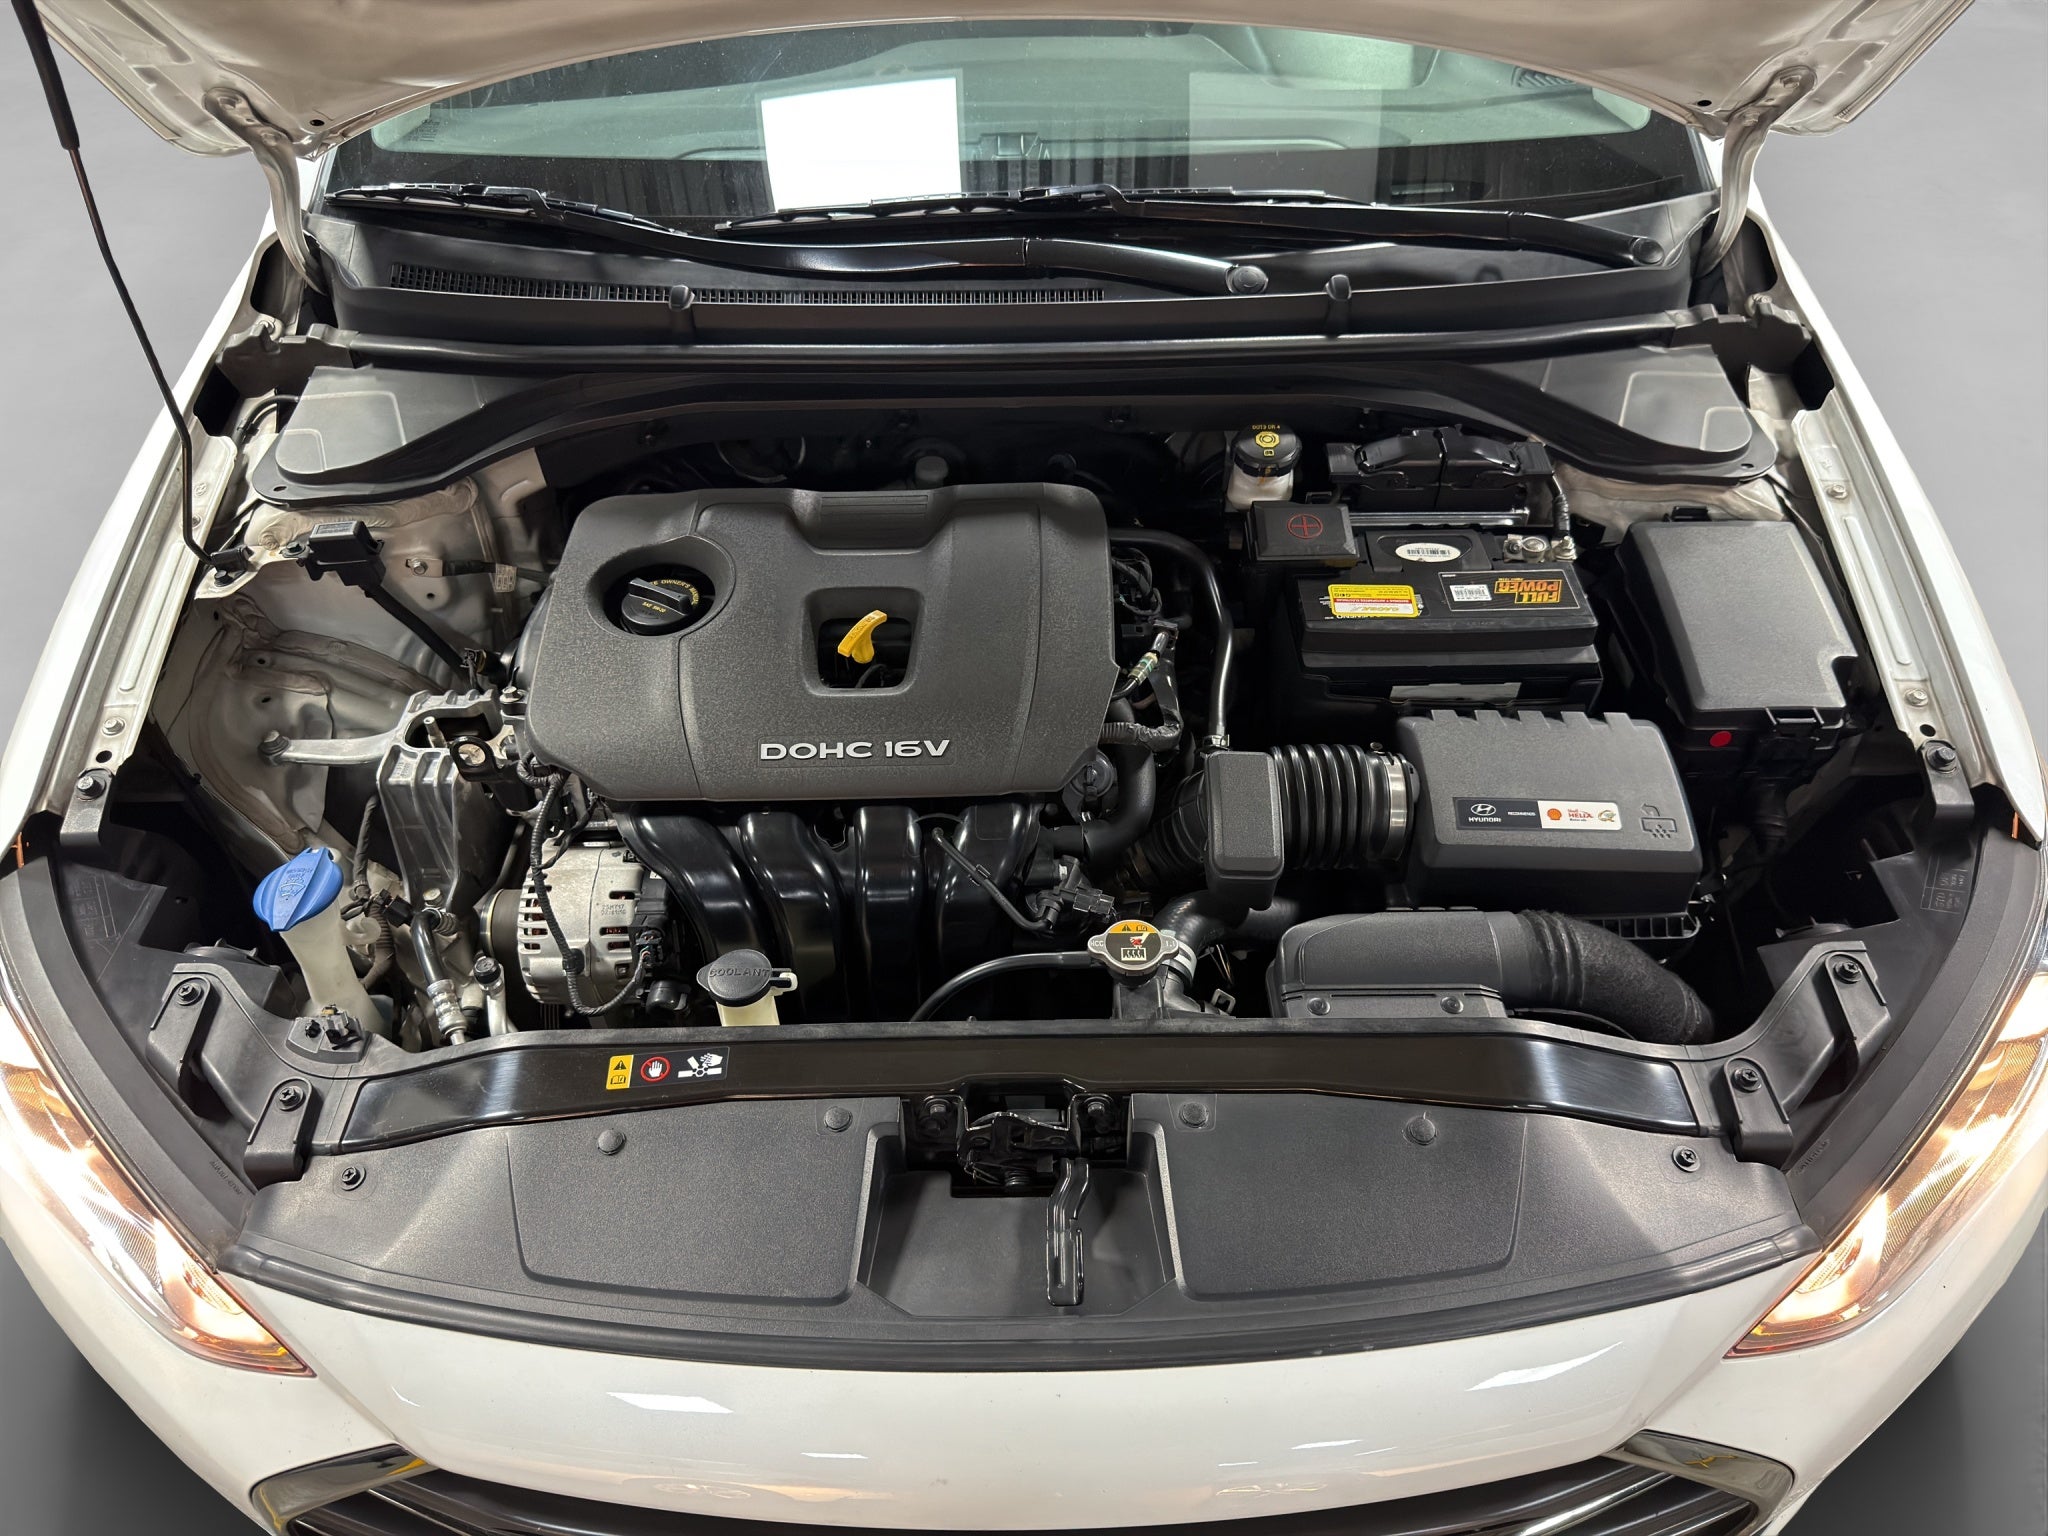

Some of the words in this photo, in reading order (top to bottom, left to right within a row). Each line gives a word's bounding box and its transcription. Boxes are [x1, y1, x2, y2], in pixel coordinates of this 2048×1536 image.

[1498, 581, 1559, 592] POWER
[1520, 591, 1558, 602] FULL
[760, 741, 873, 760] DOHC
[884, 739, 950, 758] 16V
[709, 967, 771, 978] COOLANT
